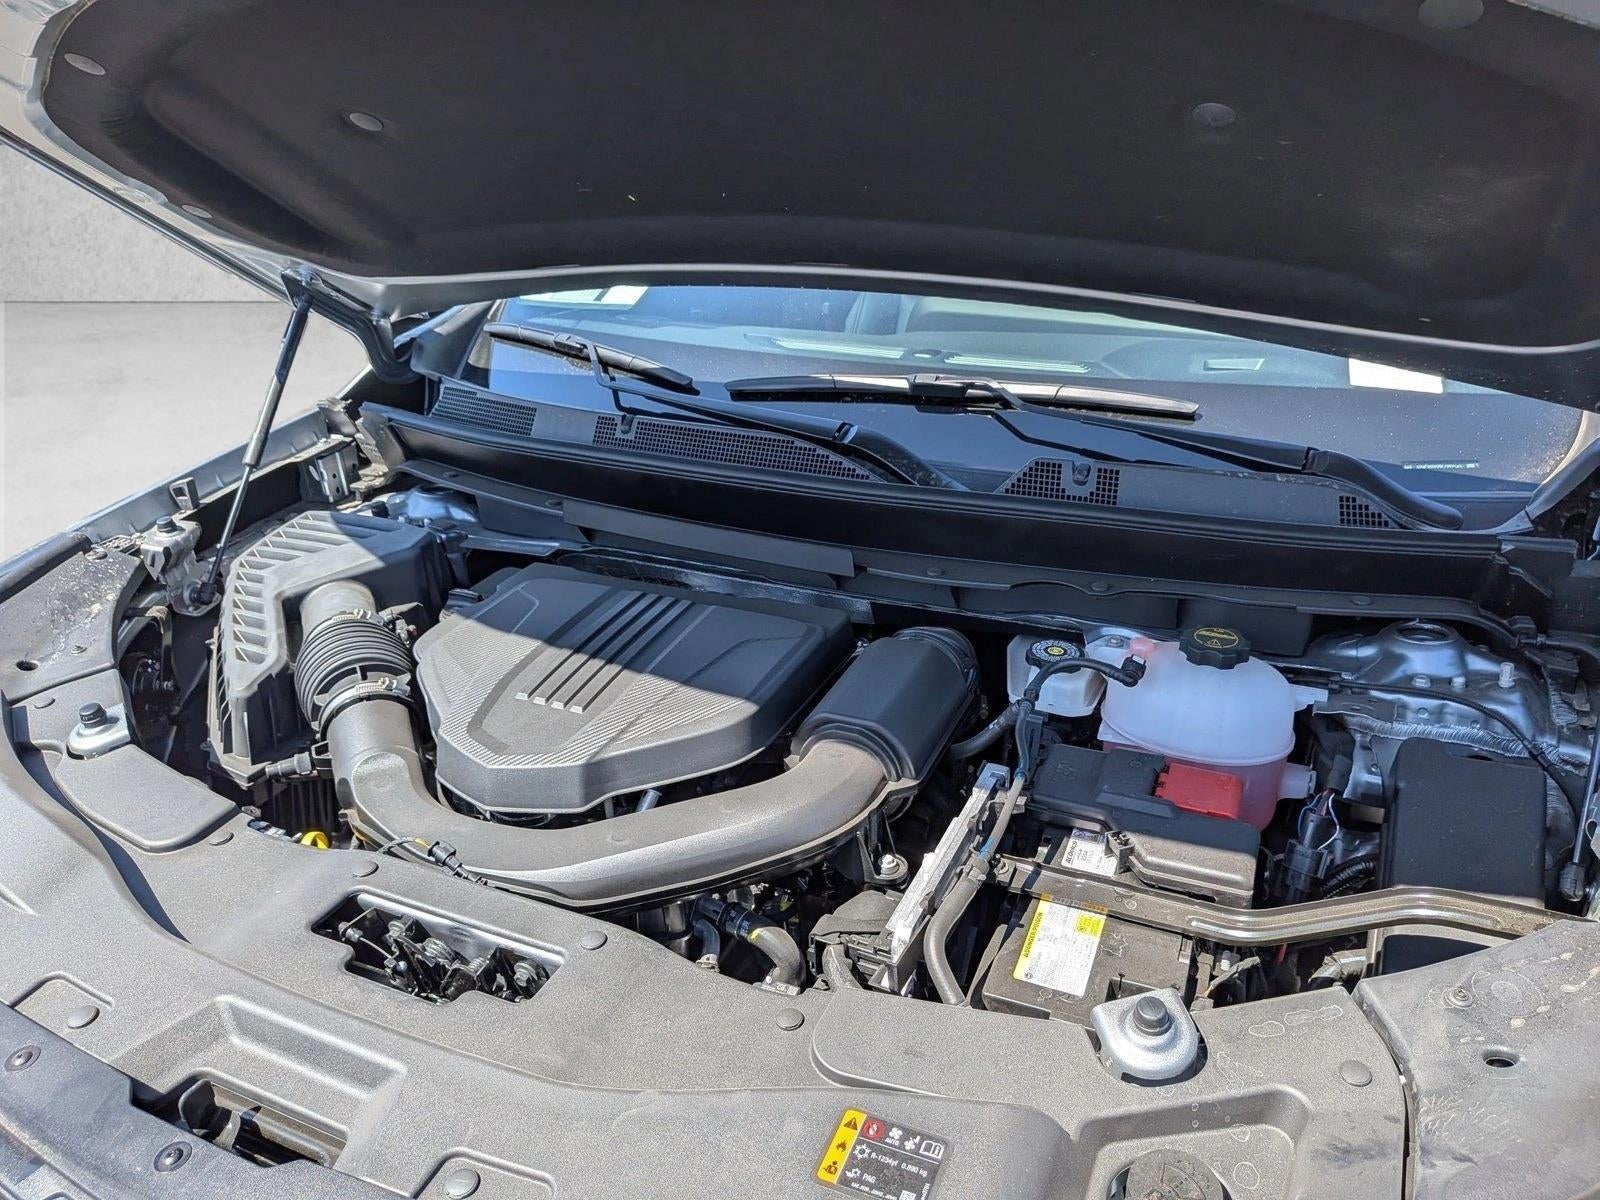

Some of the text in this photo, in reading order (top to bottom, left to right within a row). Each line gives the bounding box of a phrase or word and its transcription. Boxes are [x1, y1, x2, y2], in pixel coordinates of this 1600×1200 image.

[884, 1137, 900, 1146] AUTO
[870, 1152, 899, 1166] R-1234yf
[919, 1168, 928, 1178] kg
[862, 1173, 876, 1184] PAG
